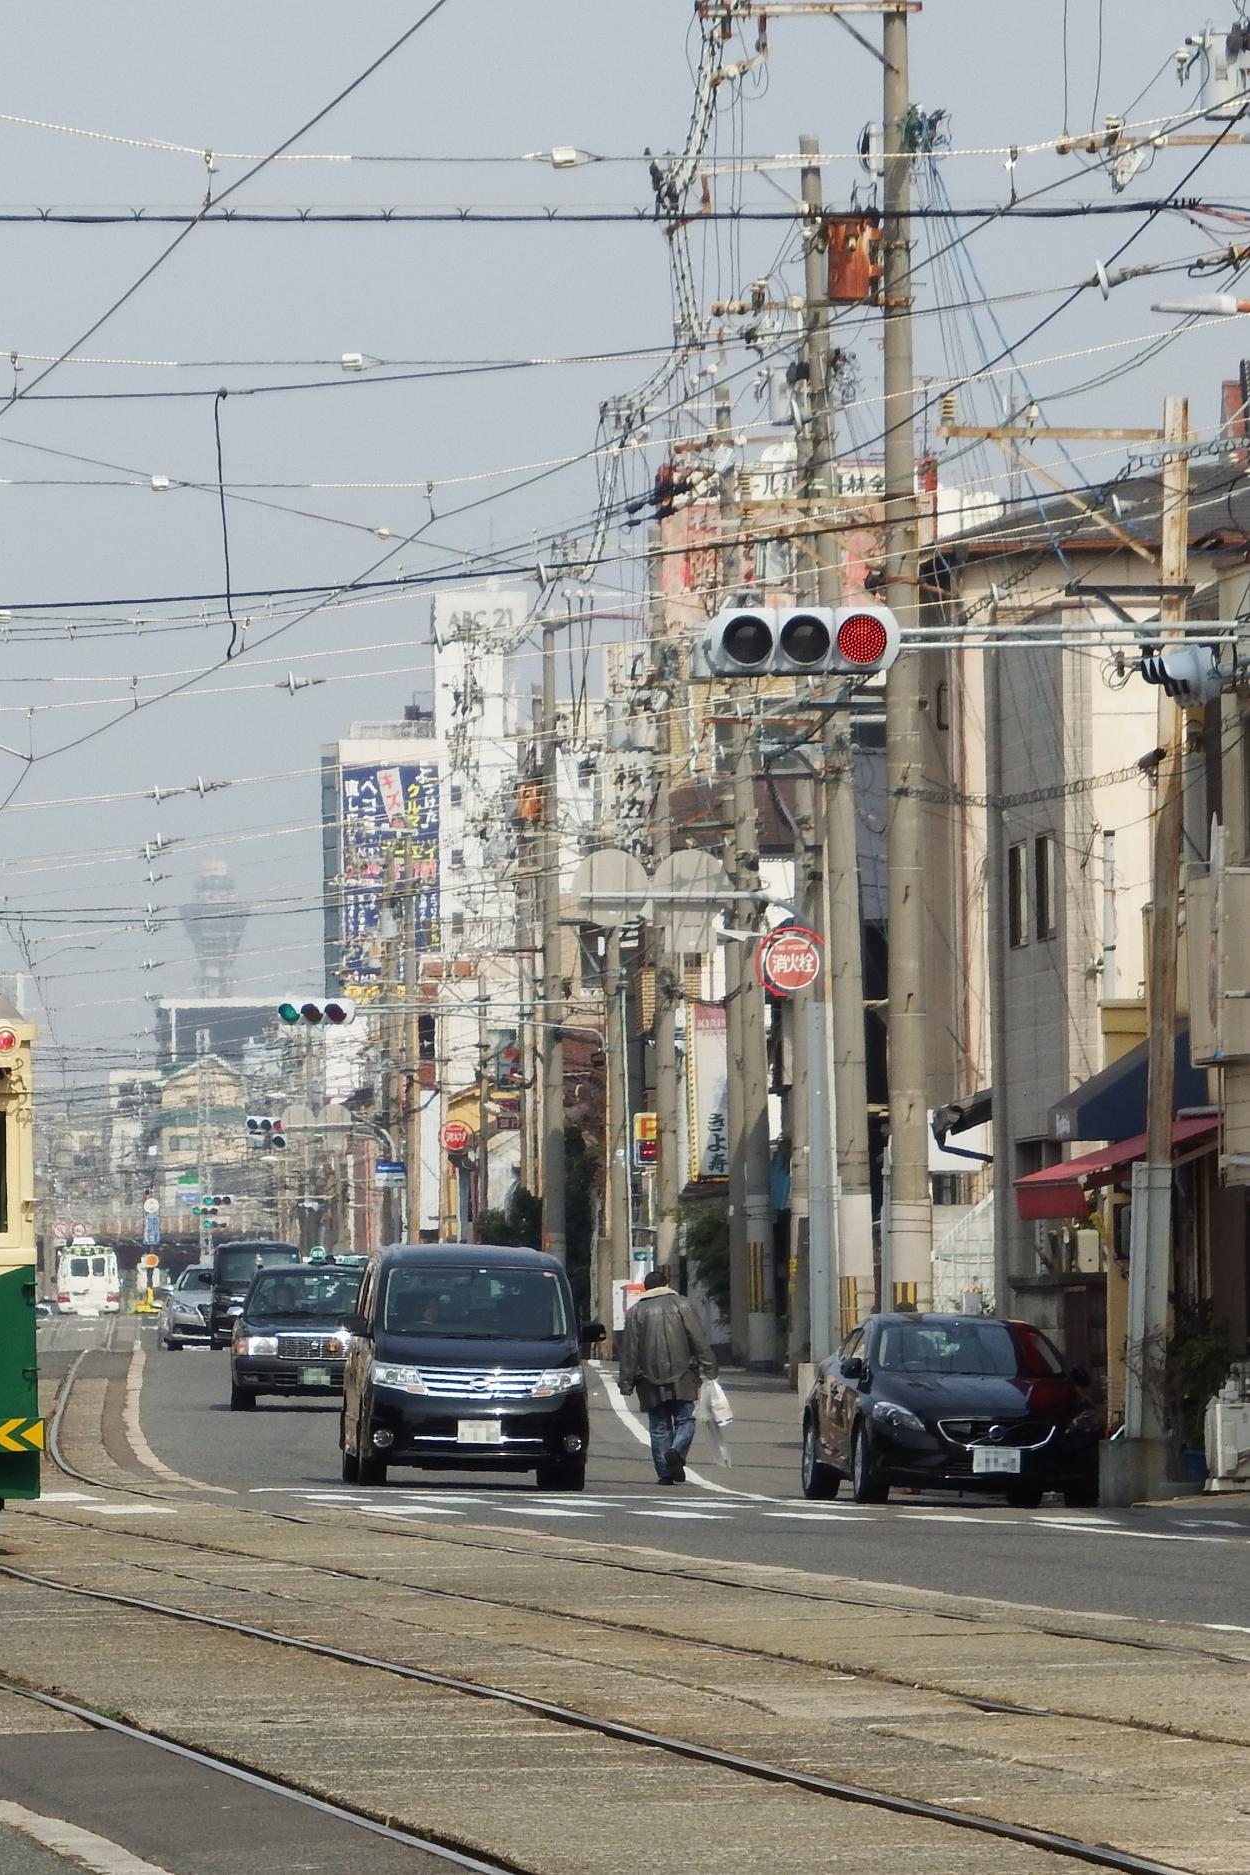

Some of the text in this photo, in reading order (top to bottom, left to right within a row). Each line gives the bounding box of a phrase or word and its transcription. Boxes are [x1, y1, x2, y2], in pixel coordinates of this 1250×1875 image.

[493, 608, 513, 628] 21
[771, 952, 815, 974] 消火栓
[640, 1117, 656, 1138] P
